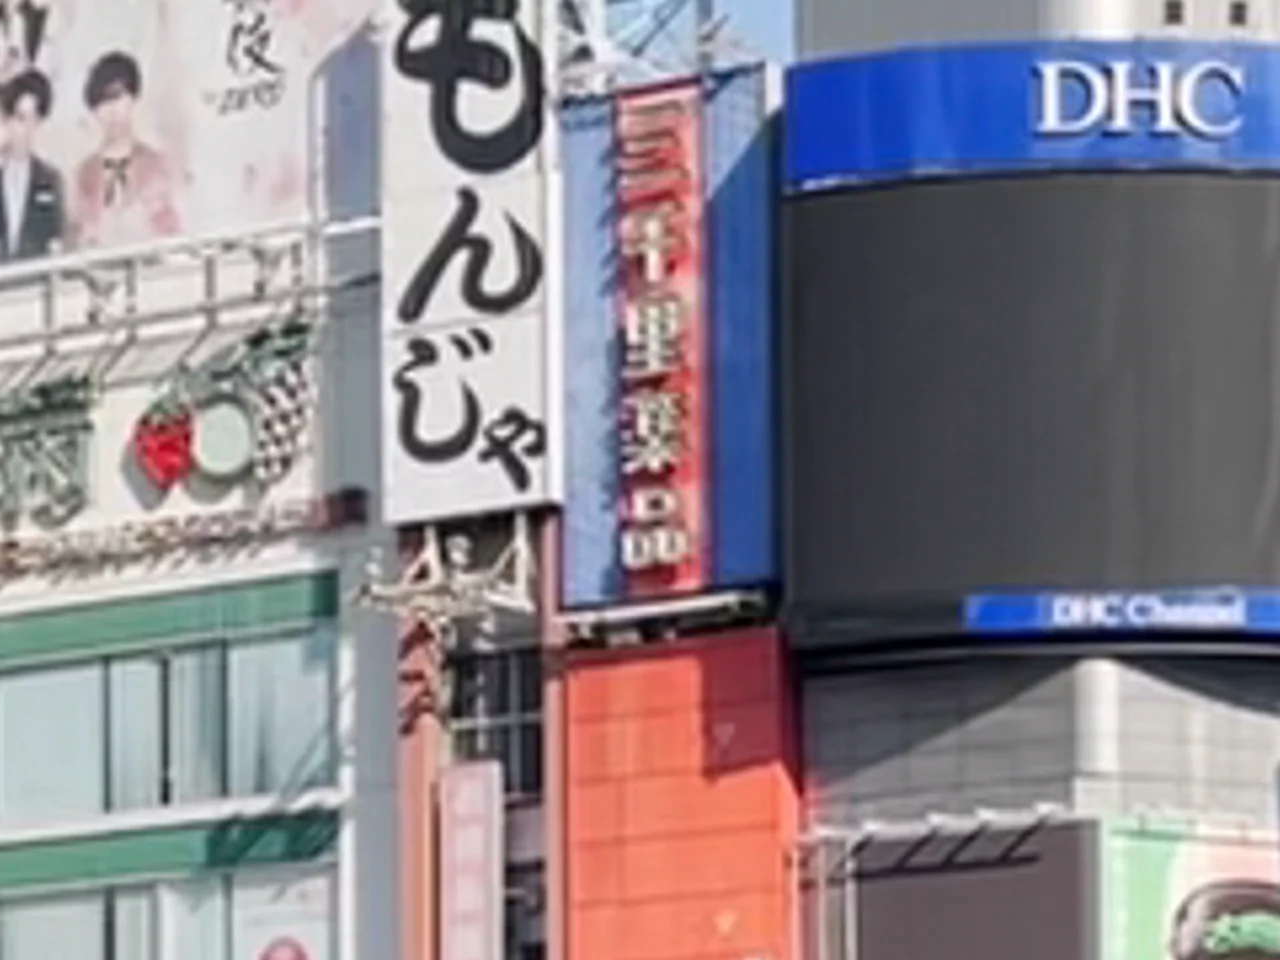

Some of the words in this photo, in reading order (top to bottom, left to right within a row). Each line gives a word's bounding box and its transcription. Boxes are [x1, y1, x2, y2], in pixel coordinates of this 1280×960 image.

[393, 0, 547, 493] もんじゃ
[620, 98, 688, 570] 三千里薬品
[1032, 60, 1243, 140] DHC
